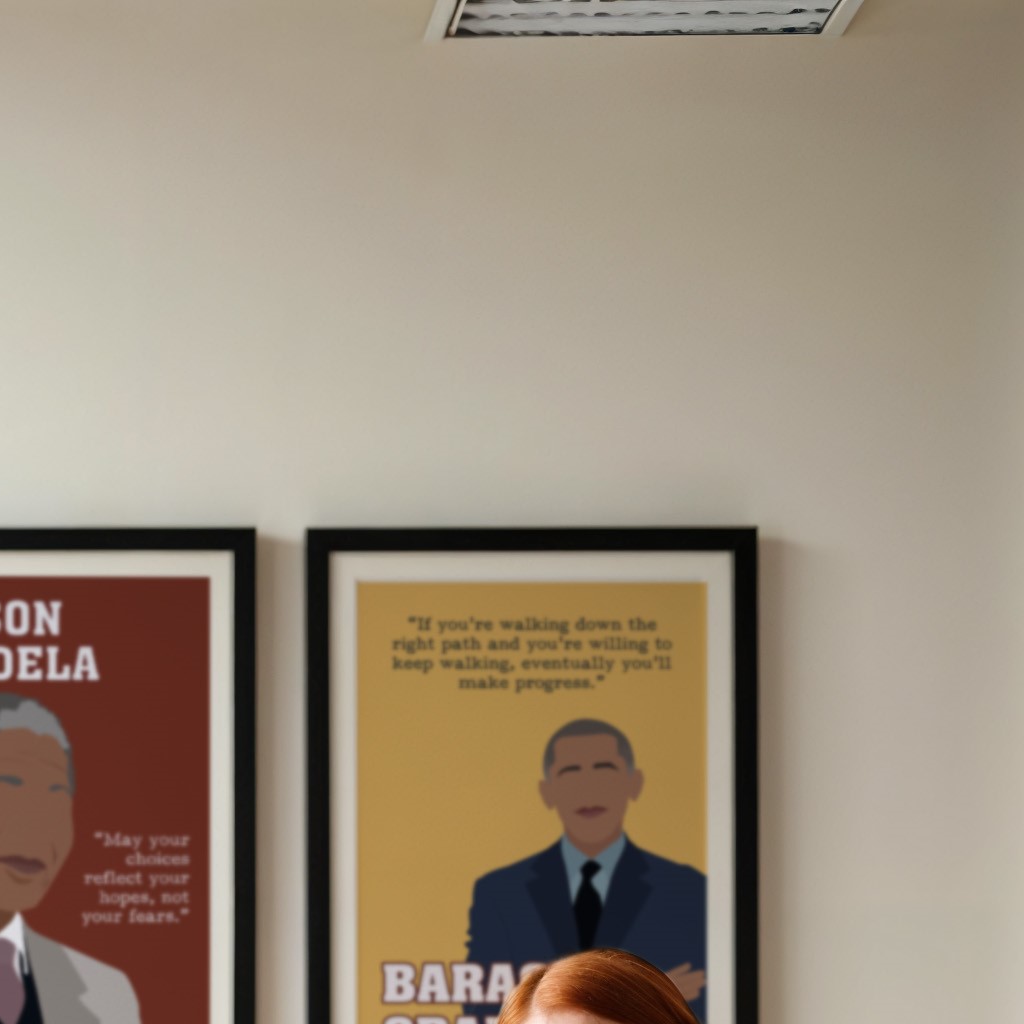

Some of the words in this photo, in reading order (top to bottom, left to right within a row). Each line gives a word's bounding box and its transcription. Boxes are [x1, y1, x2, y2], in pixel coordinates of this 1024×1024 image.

[500, 618, 569, 635] walking
[575, 617, 622, 631] down
[628, 617, 657, 631] the
[392, 637, 434, 654] right
[441, 637, 481, 654] path
[488, 636, 520, 651] and
[589, 637, 648, 655] willing
[654, 638, 673, 650] to
[392, 656, 434, 674] keep
[440, 656, 515, 674] walking,
[521, 656, 615, 672] eventually
[459, 676, 509, 689] make
[149, 835, 190, 850] your
[125, 852, 190, 866] choices
[84, 870, 142, 885] reflect
[149, 874, 190, 888] your
[100, 890, 155, 908] hopes,
[161, 891, 189, 904] not
[82, 912, 122, 926] your
[381, 961, 548, 1005] BARA
